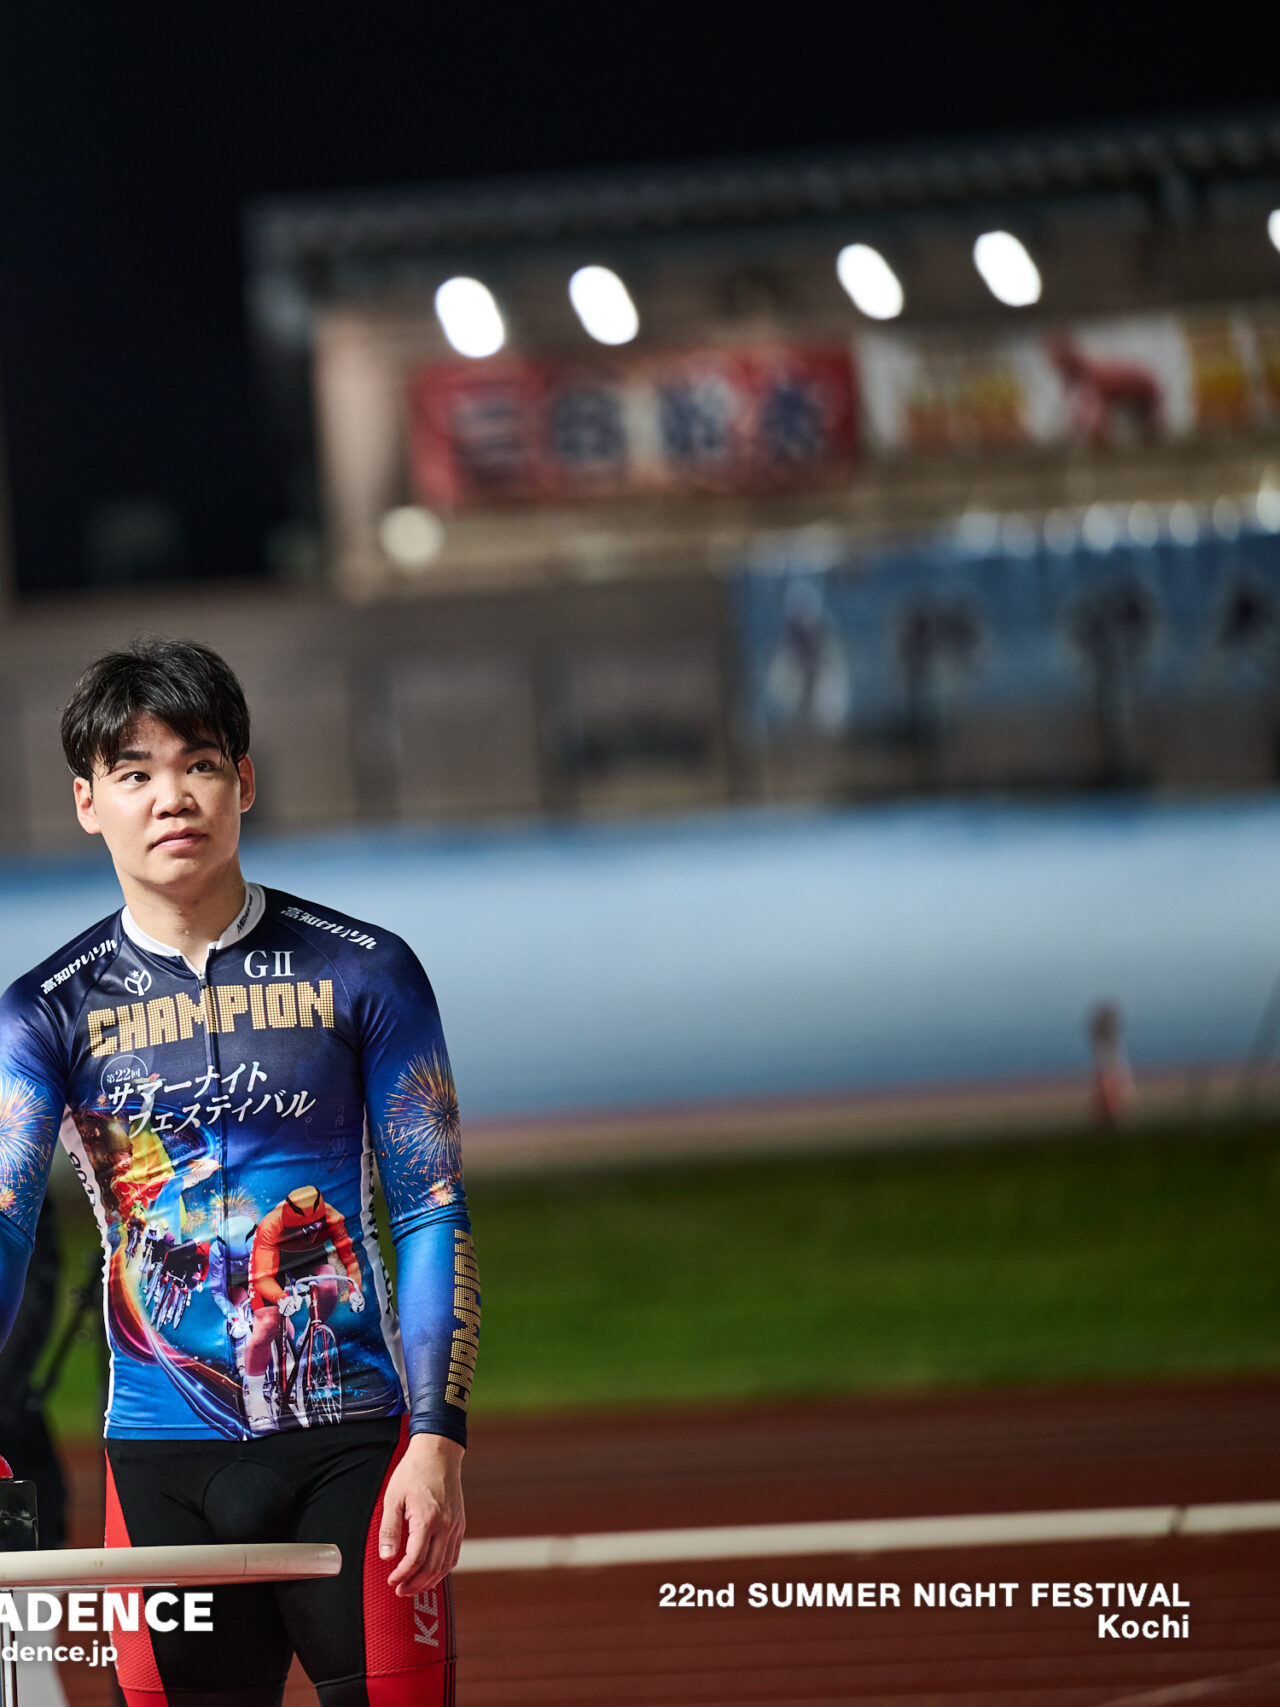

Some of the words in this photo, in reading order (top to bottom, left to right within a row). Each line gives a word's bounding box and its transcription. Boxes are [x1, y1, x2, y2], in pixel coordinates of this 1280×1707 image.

[86, 978, 335, 1058] CHAMPION
[108, 1060, 268, 1116] サマーナイト
[128, 1089, 317, 1139] フェスティバル
[444, 1228, 482, 1413] CHAMPION
